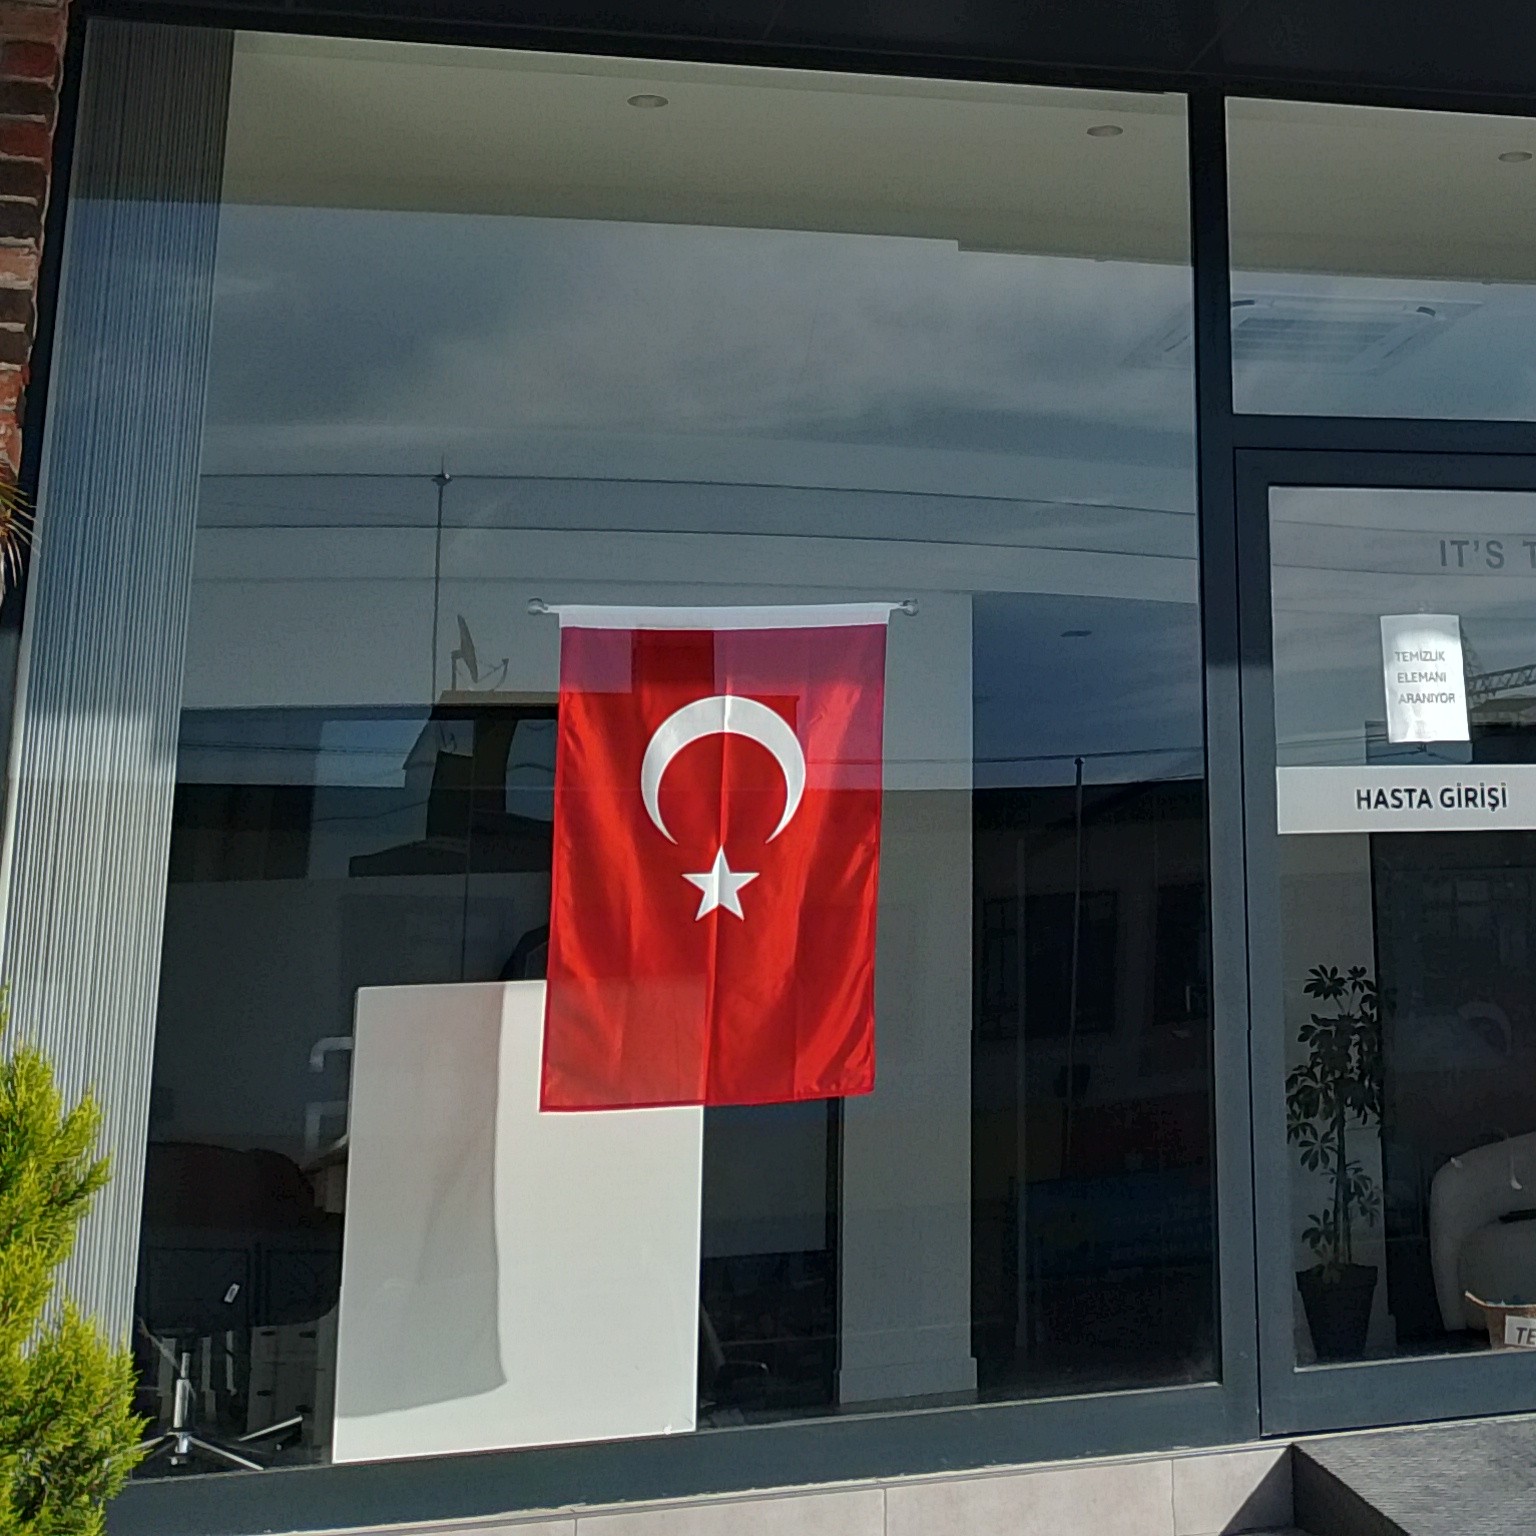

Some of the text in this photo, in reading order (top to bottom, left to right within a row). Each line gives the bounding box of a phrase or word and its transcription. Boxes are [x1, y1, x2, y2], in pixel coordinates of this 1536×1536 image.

[1397, 671, 1447, 684] ELEMANI
[1398, 692, 1456, 705] ARANIYOR
[1356, 782, 1507, 812] HASTA GİRİŞİ
